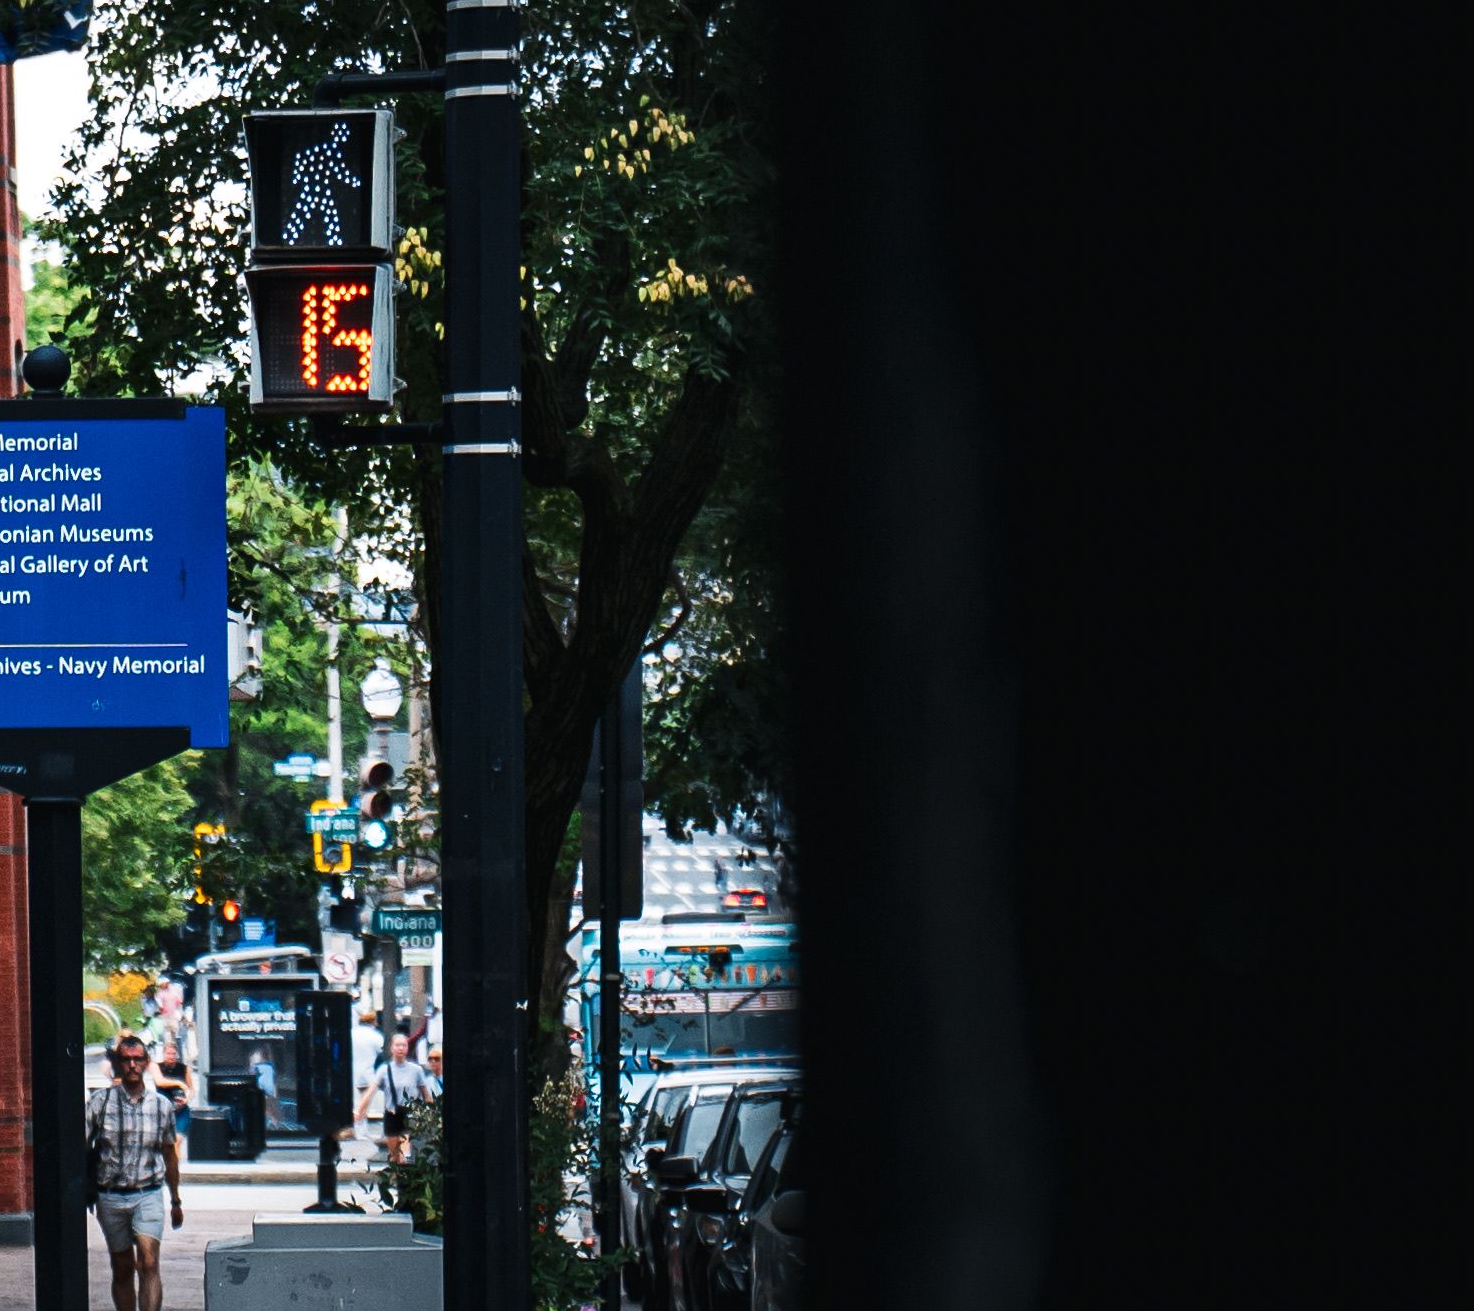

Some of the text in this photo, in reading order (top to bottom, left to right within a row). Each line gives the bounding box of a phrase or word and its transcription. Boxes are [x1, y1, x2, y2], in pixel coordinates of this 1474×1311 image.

[302, 284, 373, 392] 15
[20, 463, 101, 481] Archives
[62, 493, 101, 512] Mall
[61, 525, 153, 542] Museums
[21, 555, 88, 577] Gallery
[94, 554, 114, 572] of
[119, 555, 148, 572] Art
[59, 657, 107, 678] Navy
[113, 655, 204, 674] Memorial
[380, 913, 436, 930] Indiana
[400, 936, 433, 948] 600
[219, 1011, 228, 1021] A
